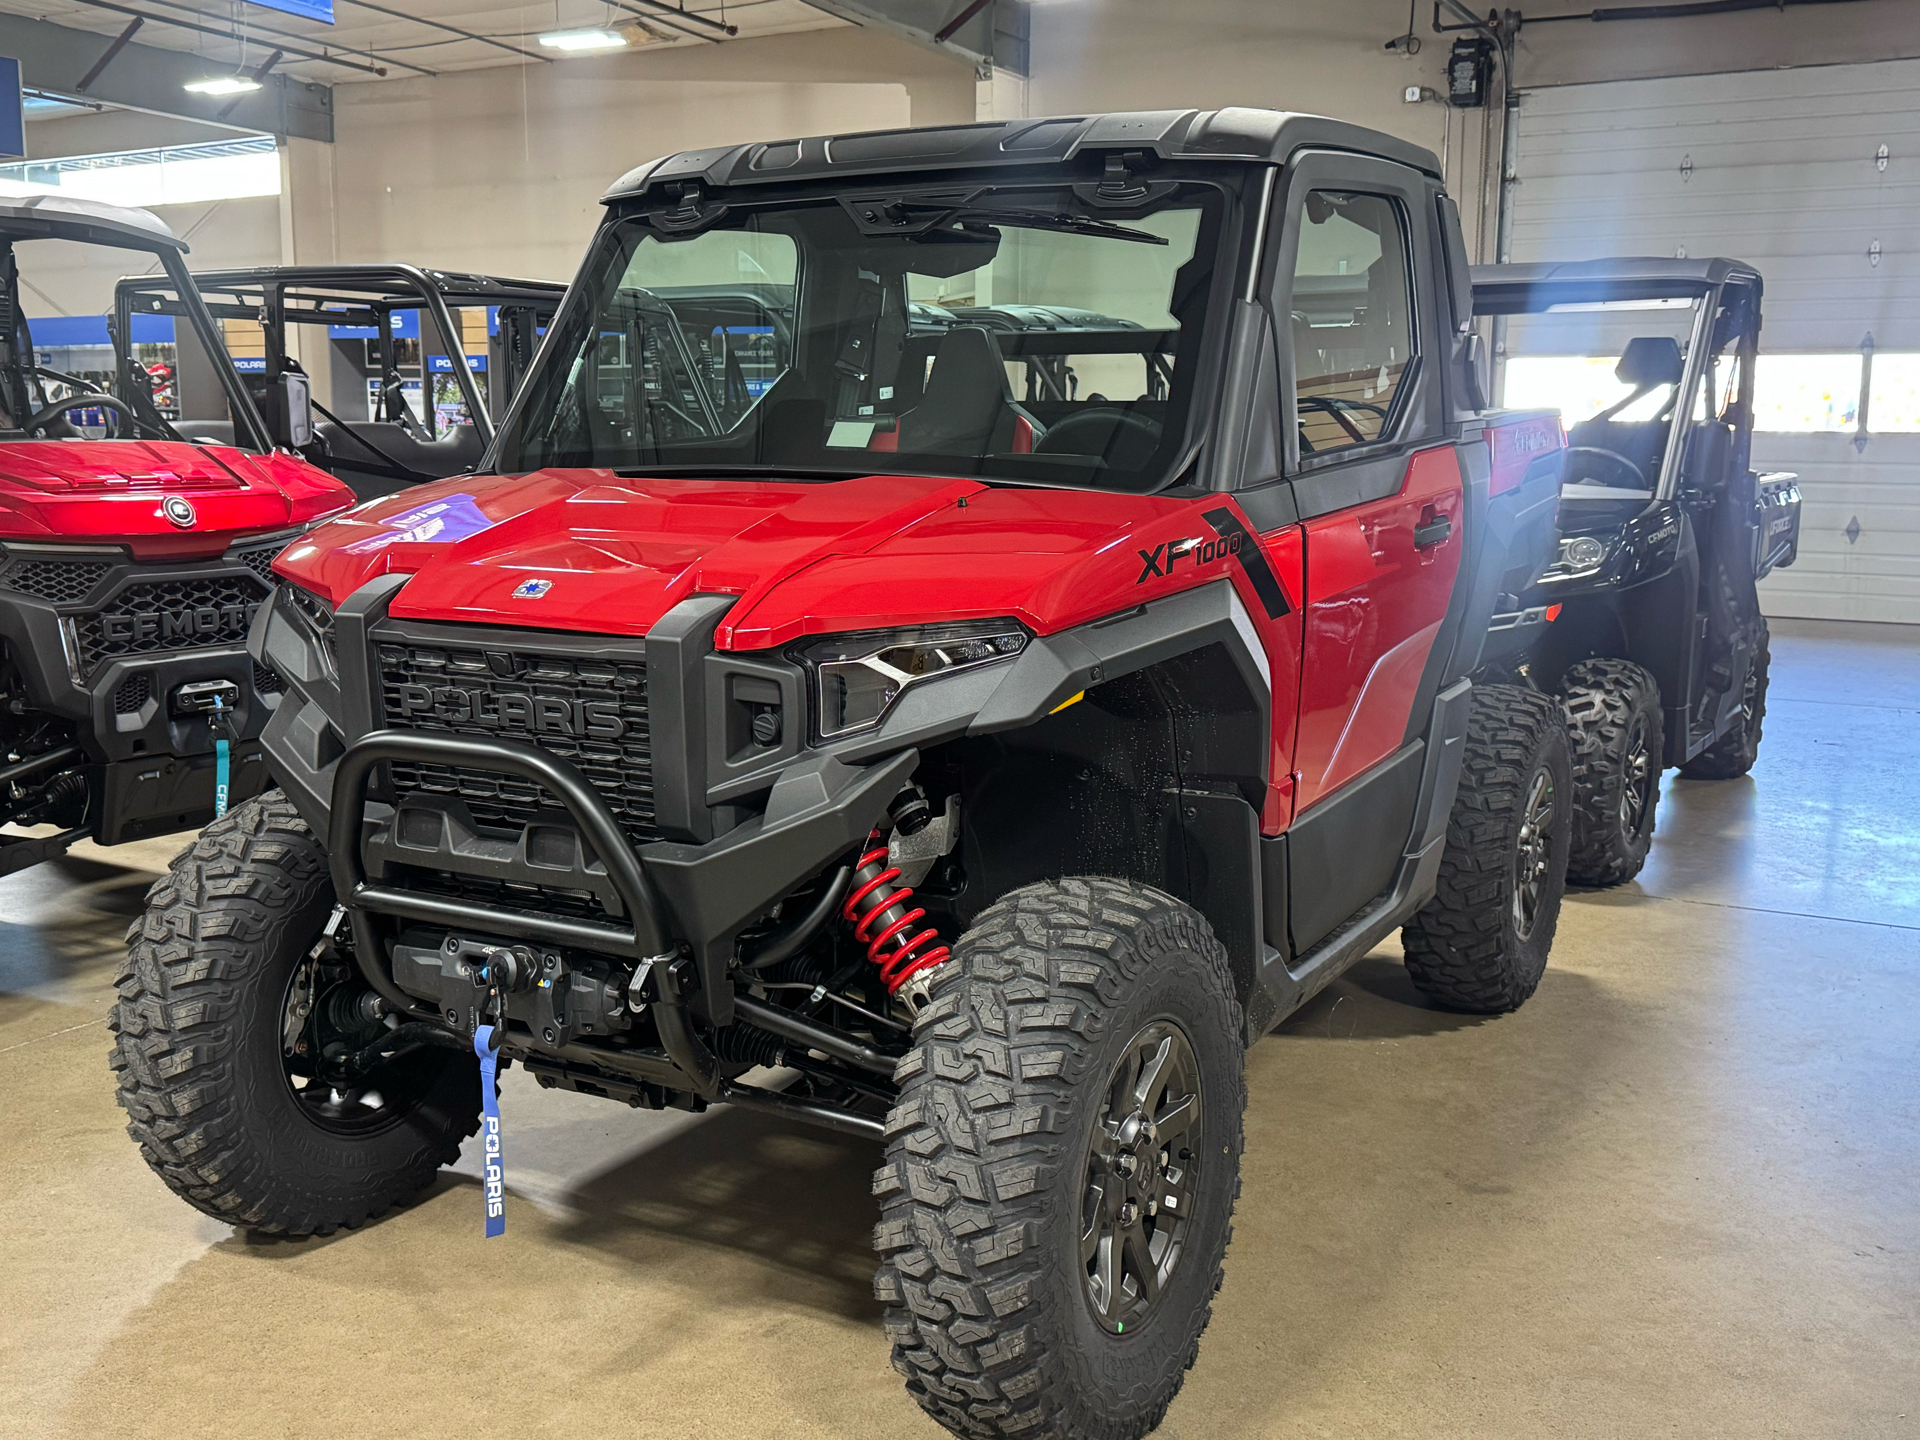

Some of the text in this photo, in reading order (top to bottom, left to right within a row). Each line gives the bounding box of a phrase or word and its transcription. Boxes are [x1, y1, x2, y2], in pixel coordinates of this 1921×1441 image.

[1136, 532, 1243, 585] XF 1000
[1648, 524, 1676, 544] CFMOTO
[400, 683, 625, 739] POLARIS
[485, 1116, 503, 1218] POLARIS
